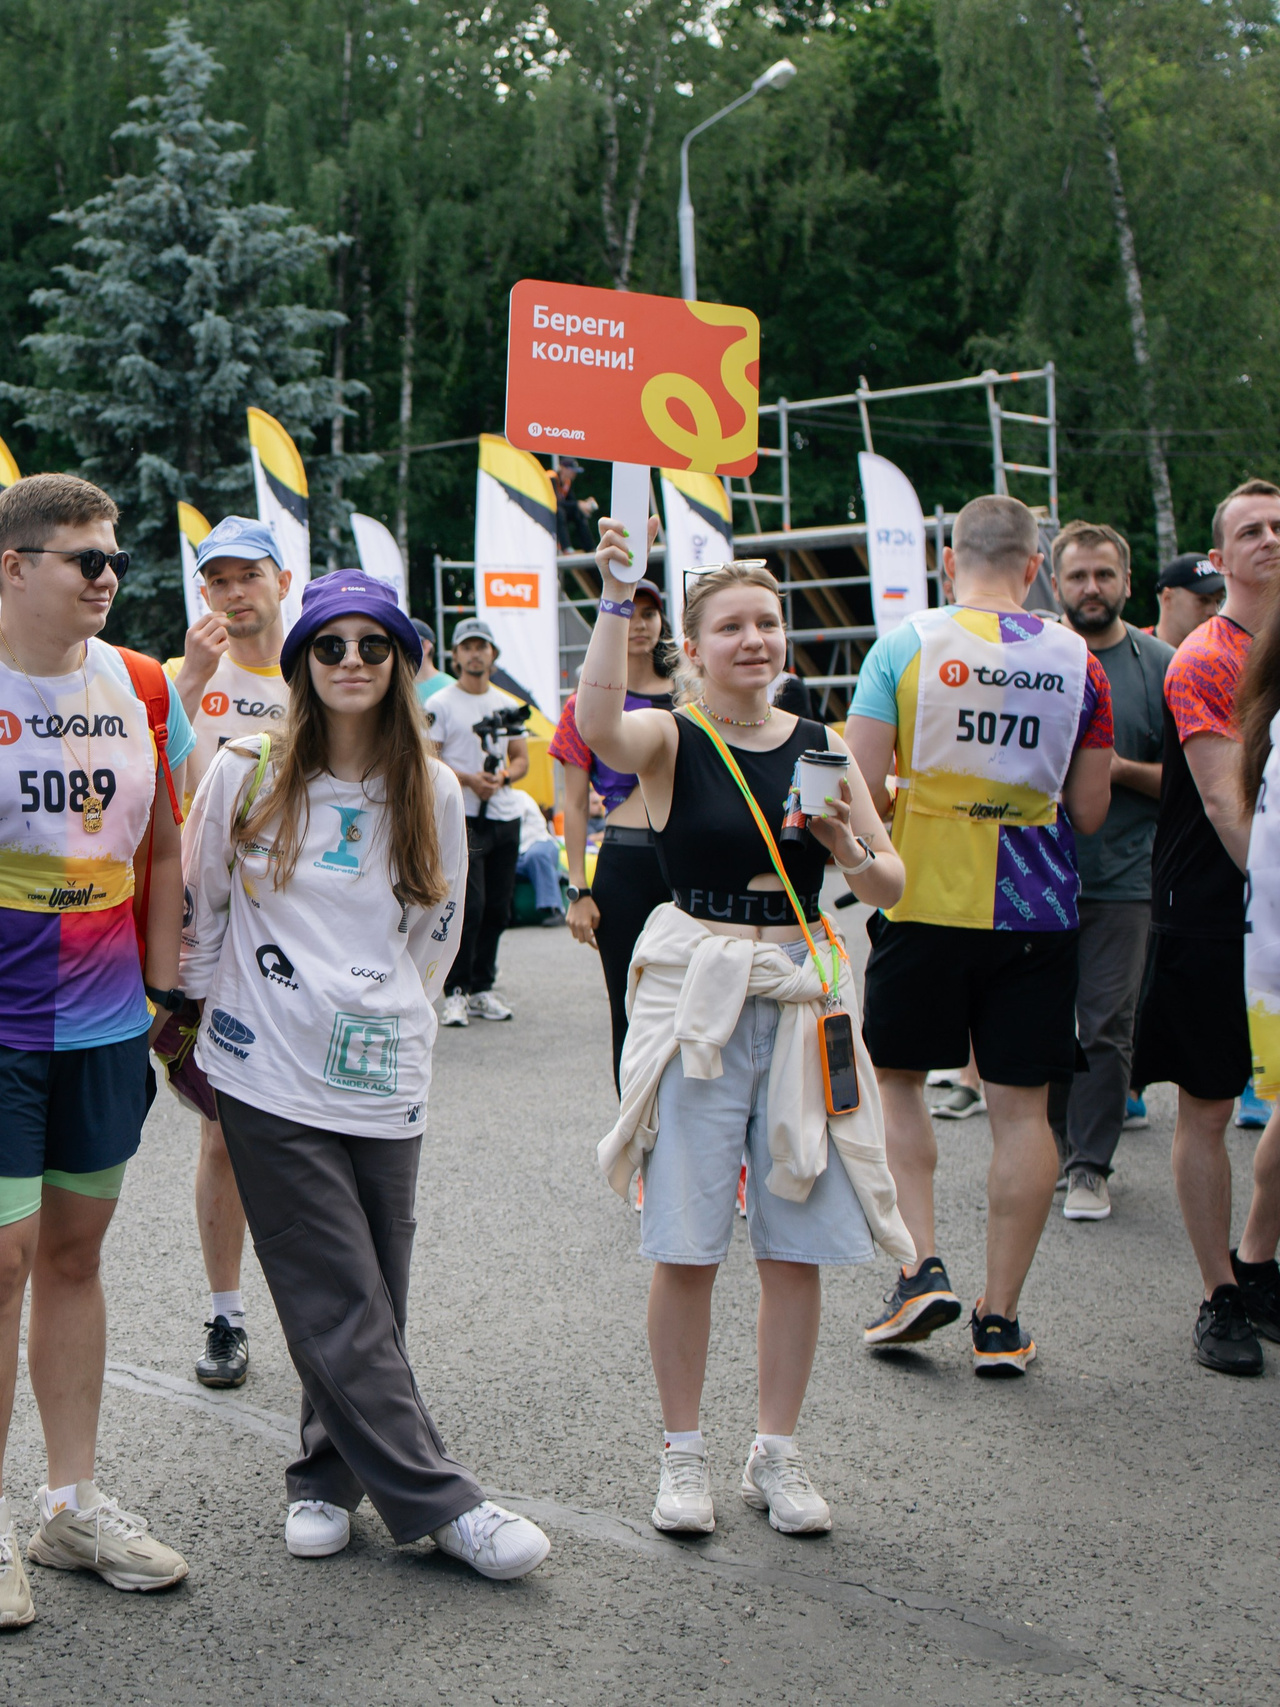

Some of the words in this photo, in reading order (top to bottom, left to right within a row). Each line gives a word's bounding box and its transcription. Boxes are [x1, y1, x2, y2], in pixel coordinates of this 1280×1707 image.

[532, 304, 625, 339] Береги
[531, 340, 634, 371] колени!
[543, 426, 586, 441] team
[973, 666, 1065, 694] team
[232, 698, 287, 720] tea
[24, 713, 128, 739] team
[956, 709, 1041, 750] 5070
[18, 768, 117, 814] 5089
[1000, 832, 1033, 877] Yandex
[48, 882, 95, 910] URBAN
[689, 888, 820, 921] FUTURE
[997, 876, 1037, 922] Yandex
[1041, 886, 1071, 929] Yandex
[329, 1076, 370, 1090] YANDEX
[370, 1082, 393, 1093] ADS
